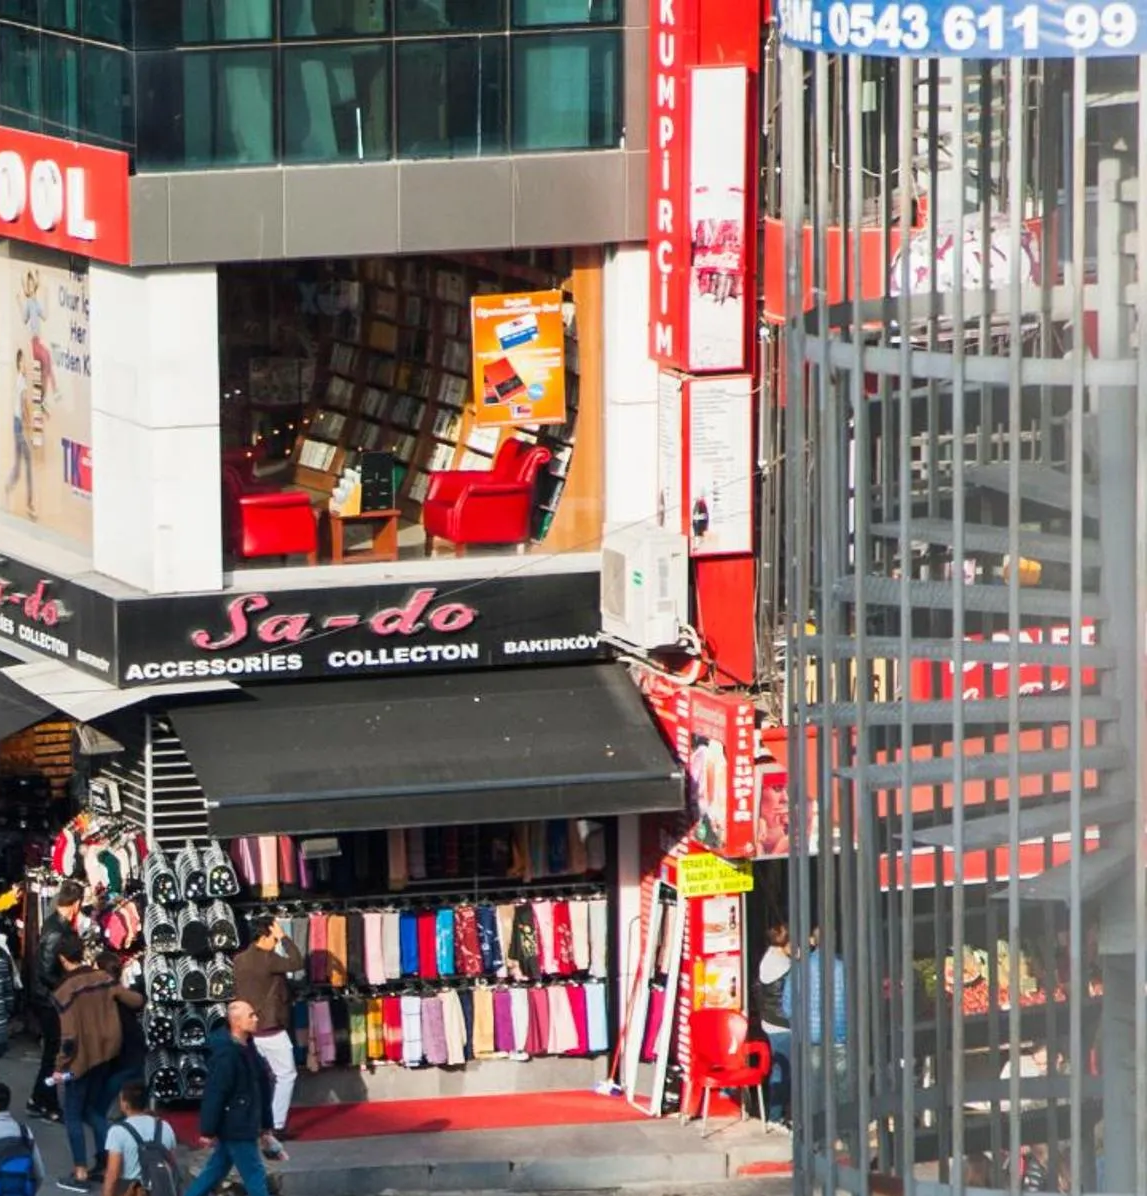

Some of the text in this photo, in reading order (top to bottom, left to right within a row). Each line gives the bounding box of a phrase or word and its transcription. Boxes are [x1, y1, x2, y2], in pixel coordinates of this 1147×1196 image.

[828, 3, 930, 47] 0543
[943, 3, 1039, 50] 611
[1064, 3, 1137, 49] 99
[190, 586, 479, 650] Sa-do
[125, 635, 601, 681] ACCESSORİES COLLECTON BAKIRKÖY
